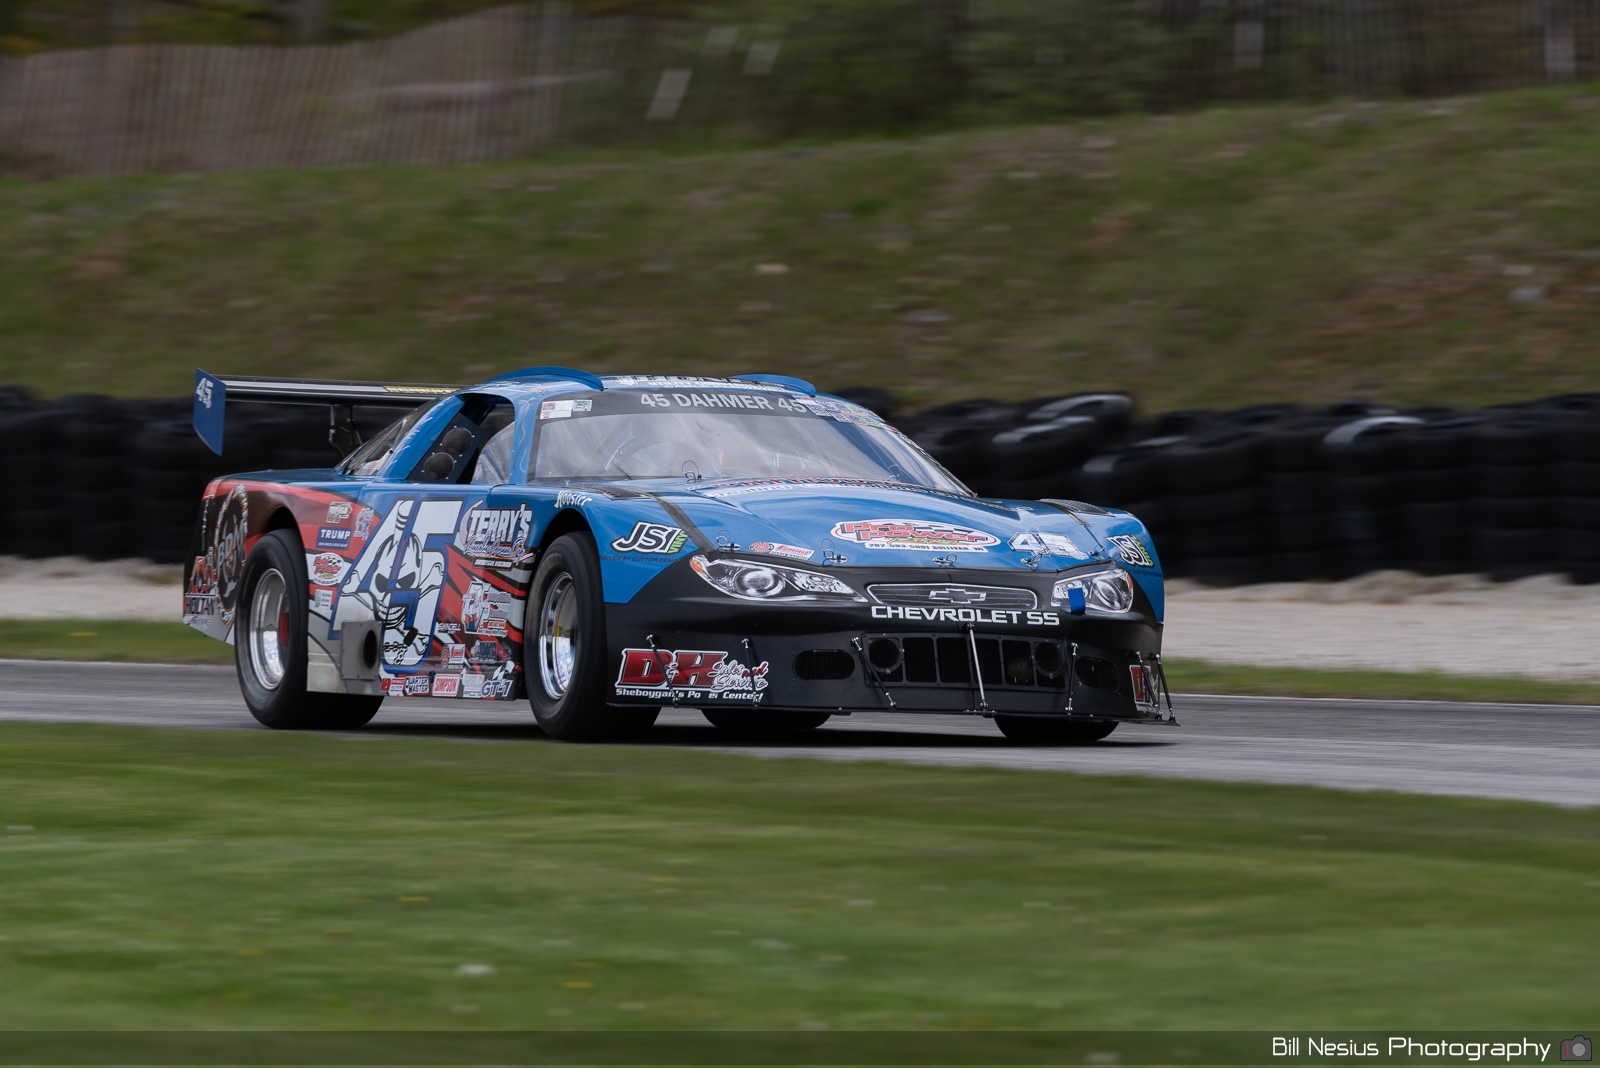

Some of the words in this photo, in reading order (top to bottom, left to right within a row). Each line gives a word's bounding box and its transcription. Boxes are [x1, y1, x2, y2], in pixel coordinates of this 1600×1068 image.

[195, 377, 214, 408] 45
[640, 393, 671, 408] 45
[671, 393, 774, 410] DAHMER
[777, 398, 807, 413] 45
[467, 503, 532, 543] TERRY'S
[840, 523, 914, 534] Pro
[320, 529, 351, 540] TRUMP
[331, 499, 463, 667] 45
[871, 606, 1021, 624] CHEVROLET
[1027, 611, 1060, 626] SS
[707, 660, 744, 677] Sales
[406, 676, 428, 685] QUARTER
[408, 684, 428, 693] MASTER
[434, 678, 457, 692] SIMPSON
[482, 680, 512, 698] GT-1
[615, 688, 685, 699] Sheboygan's
[687, 690, 718, 699] Poer
